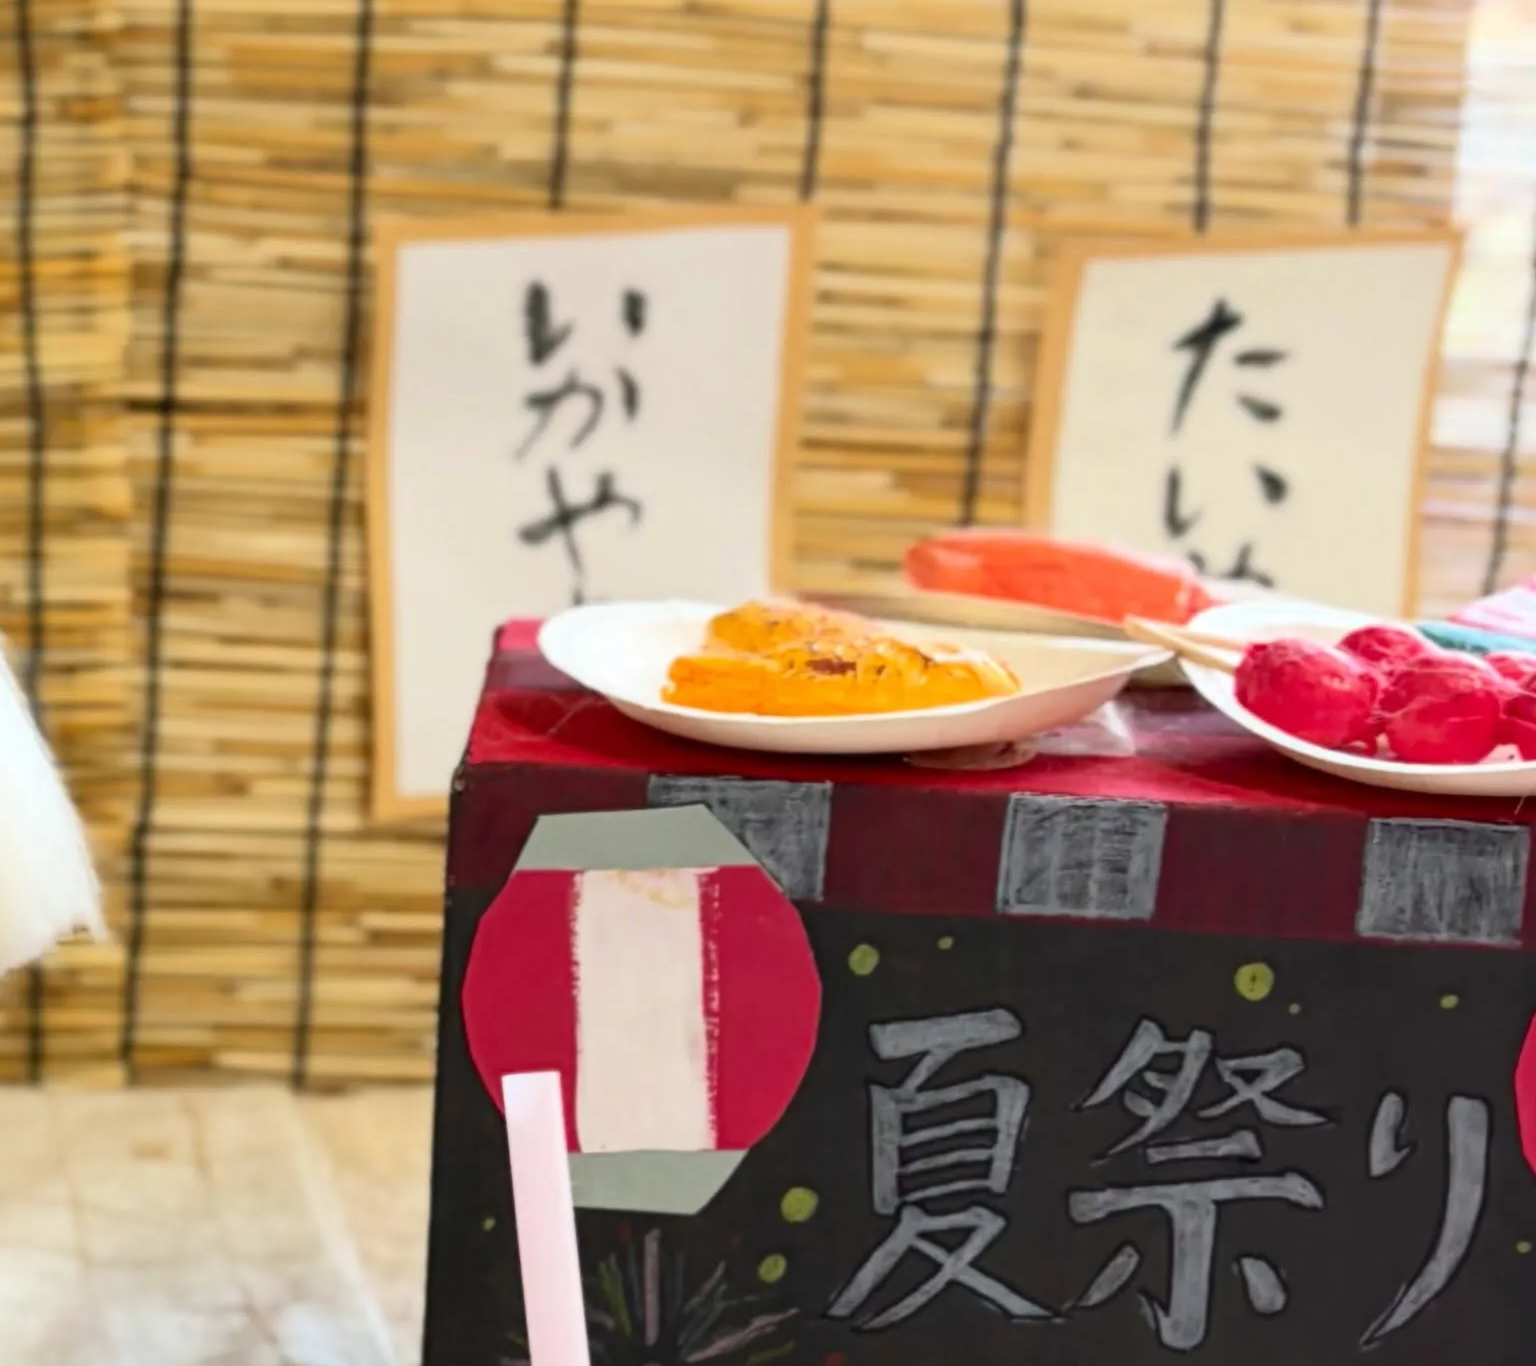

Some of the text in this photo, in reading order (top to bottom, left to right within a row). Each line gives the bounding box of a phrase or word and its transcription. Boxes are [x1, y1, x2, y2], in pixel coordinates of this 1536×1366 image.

[516, 280, 648, 605] いかや
[823, 1007, 1492, 1353] 夏祭り
